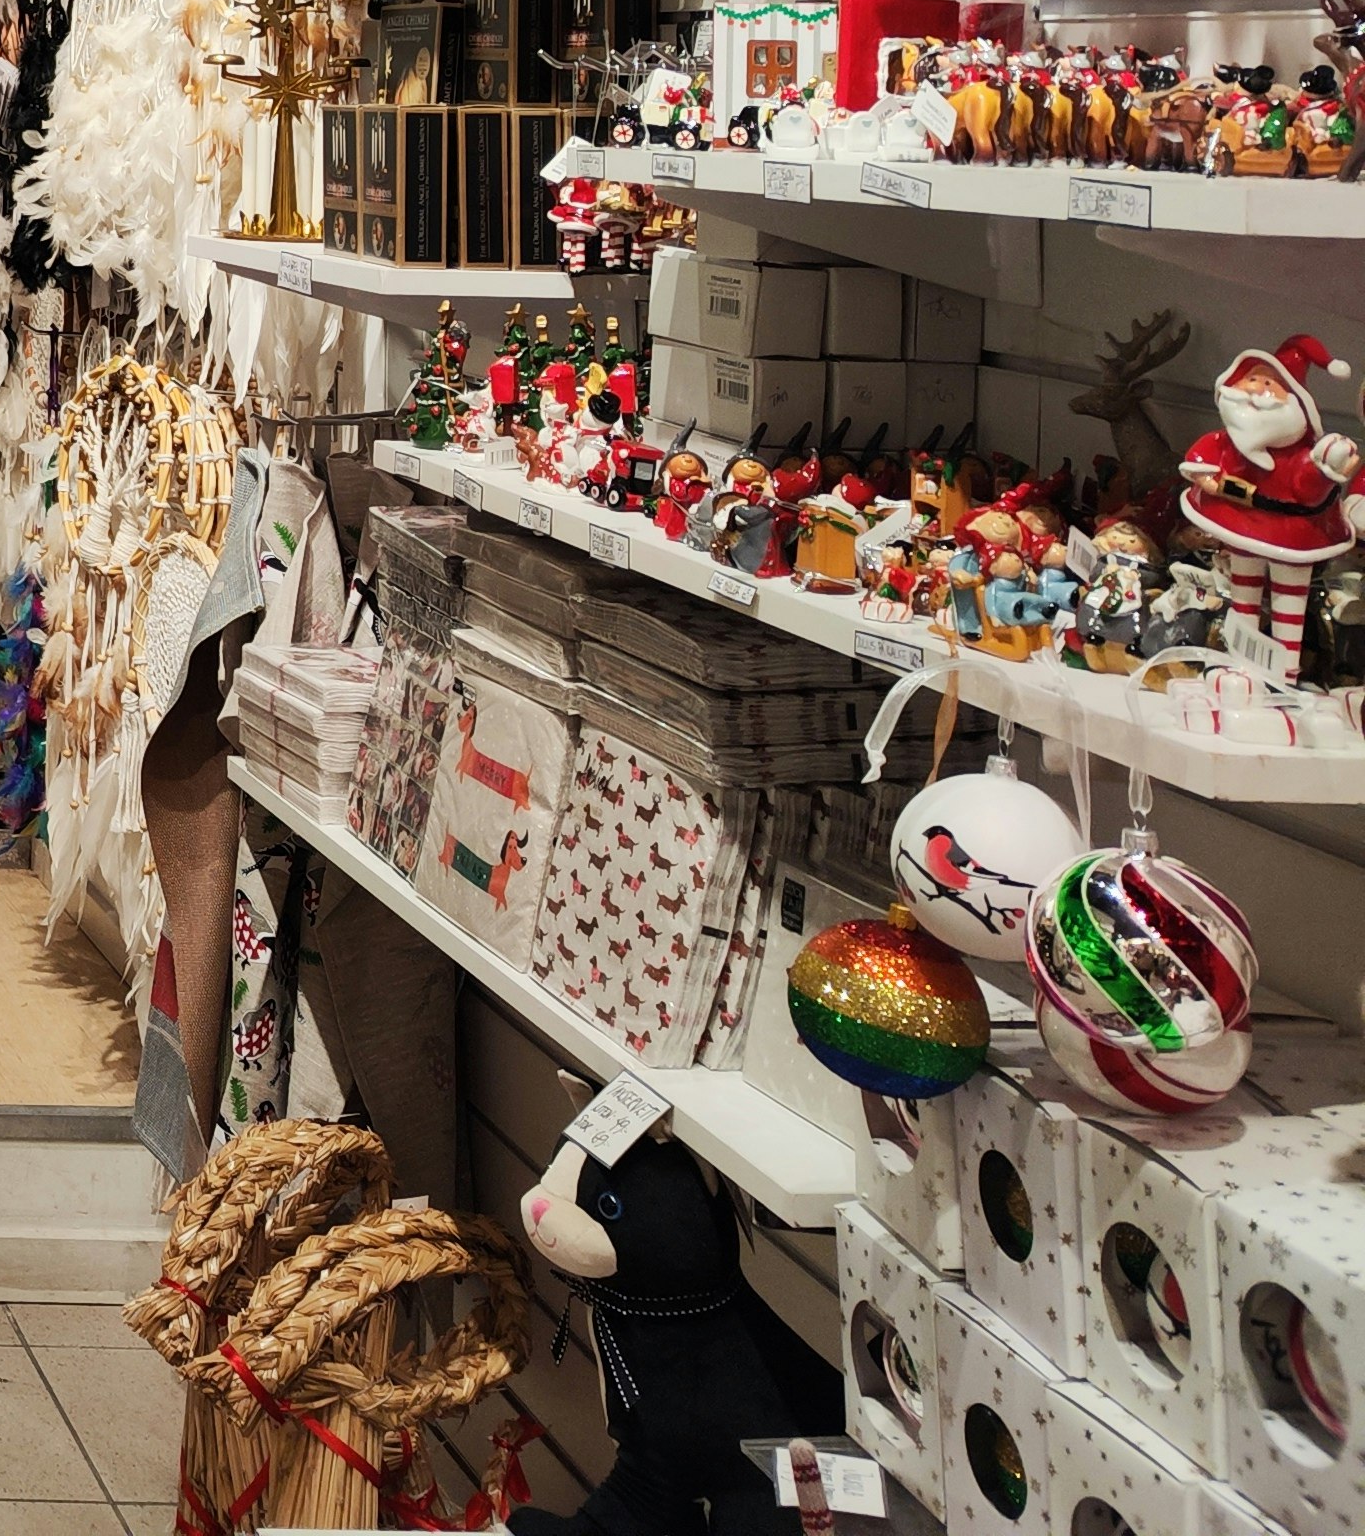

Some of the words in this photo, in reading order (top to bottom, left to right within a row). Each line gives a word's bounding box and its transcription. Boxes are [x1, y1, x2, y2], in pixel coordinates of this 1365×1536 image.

[386, 15, 405, 26] ANGEL
[418, 117, 426, 152] COMPANY
[531, 120, 540, 154] COMPANY
[418, 154, 426, 182] CHIMES
[531, 157, 540, 184] CHIMES
[418, 184, 426, 207] ANGEL
[478, 184, 486, 207] ANGEL
[532, 186, 540, 209] ANGEL
[418, 209, 426, 243] ORIGINAL
[532, 211, 540, 245] ORIGINAL
[418, 245, 426, 258] THE
[479, 244, 487, 258] THE
[532, 247, 540, 260] THE
[479, 762, 508, 787] MERRY
